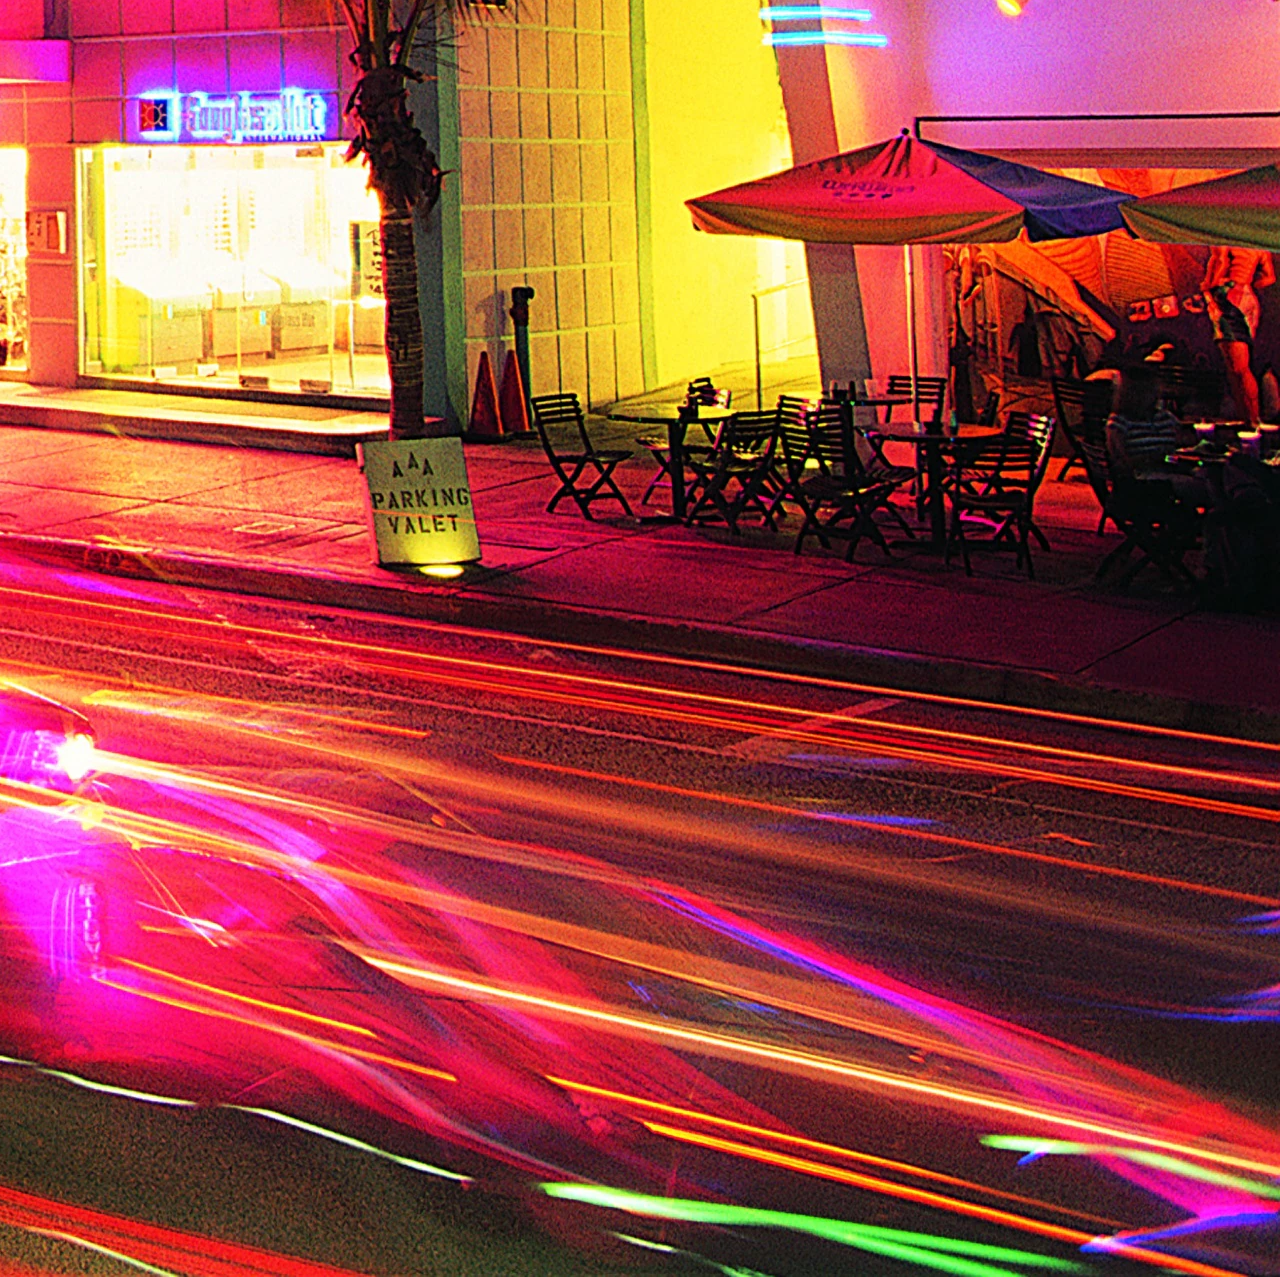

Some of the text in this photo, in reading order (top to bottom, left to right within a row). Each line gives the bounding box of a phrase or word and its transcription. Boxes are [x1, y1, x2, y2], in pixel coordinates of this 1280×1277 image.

[392, 451, 434, 478] AAA
[371, 487, 470, 509] PARKING
[387, 514, 458, 534] VALET
